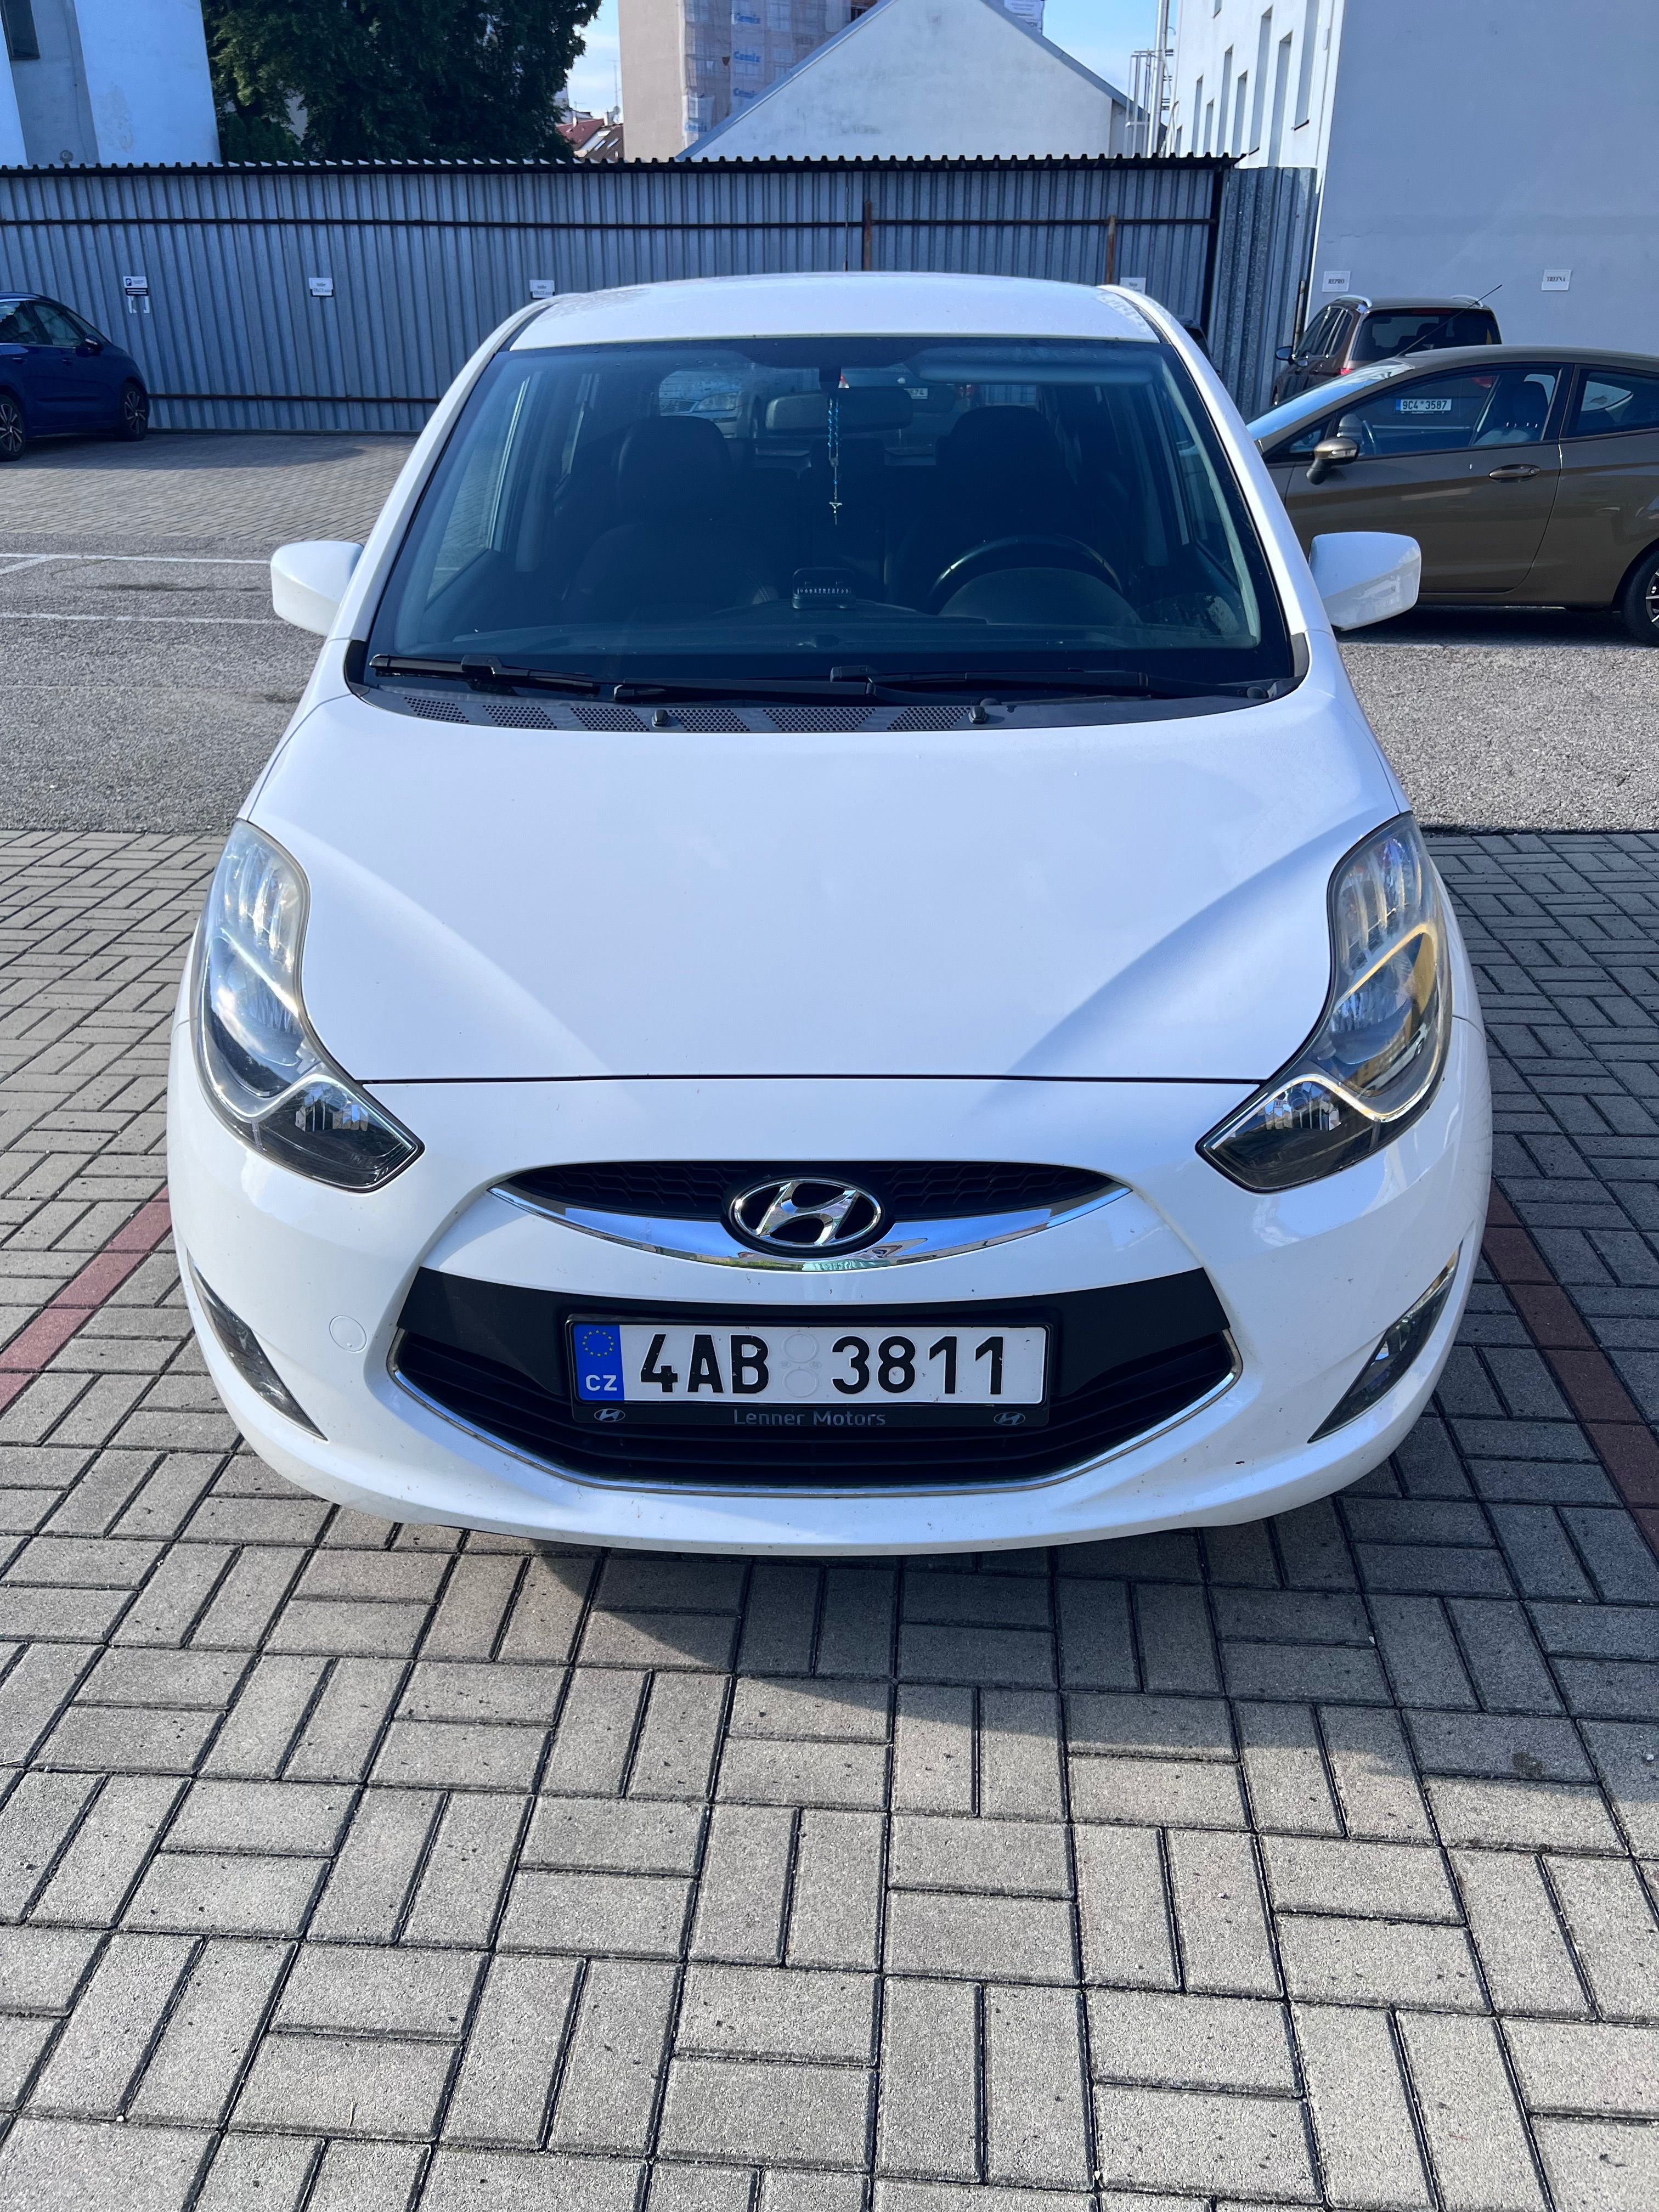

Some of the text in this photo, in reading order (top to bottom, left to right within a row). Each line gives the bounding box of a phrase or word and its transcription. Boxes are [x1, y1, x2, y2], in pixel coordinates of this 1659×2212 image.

[1402, 400, 1447, 410] 9C4 3587
[640, 1334, 1004, 1395] 4AB 3811
[585, 1374, 618, 1392] CZ
[733, 1409, 886, 1426] Lenner Motors
